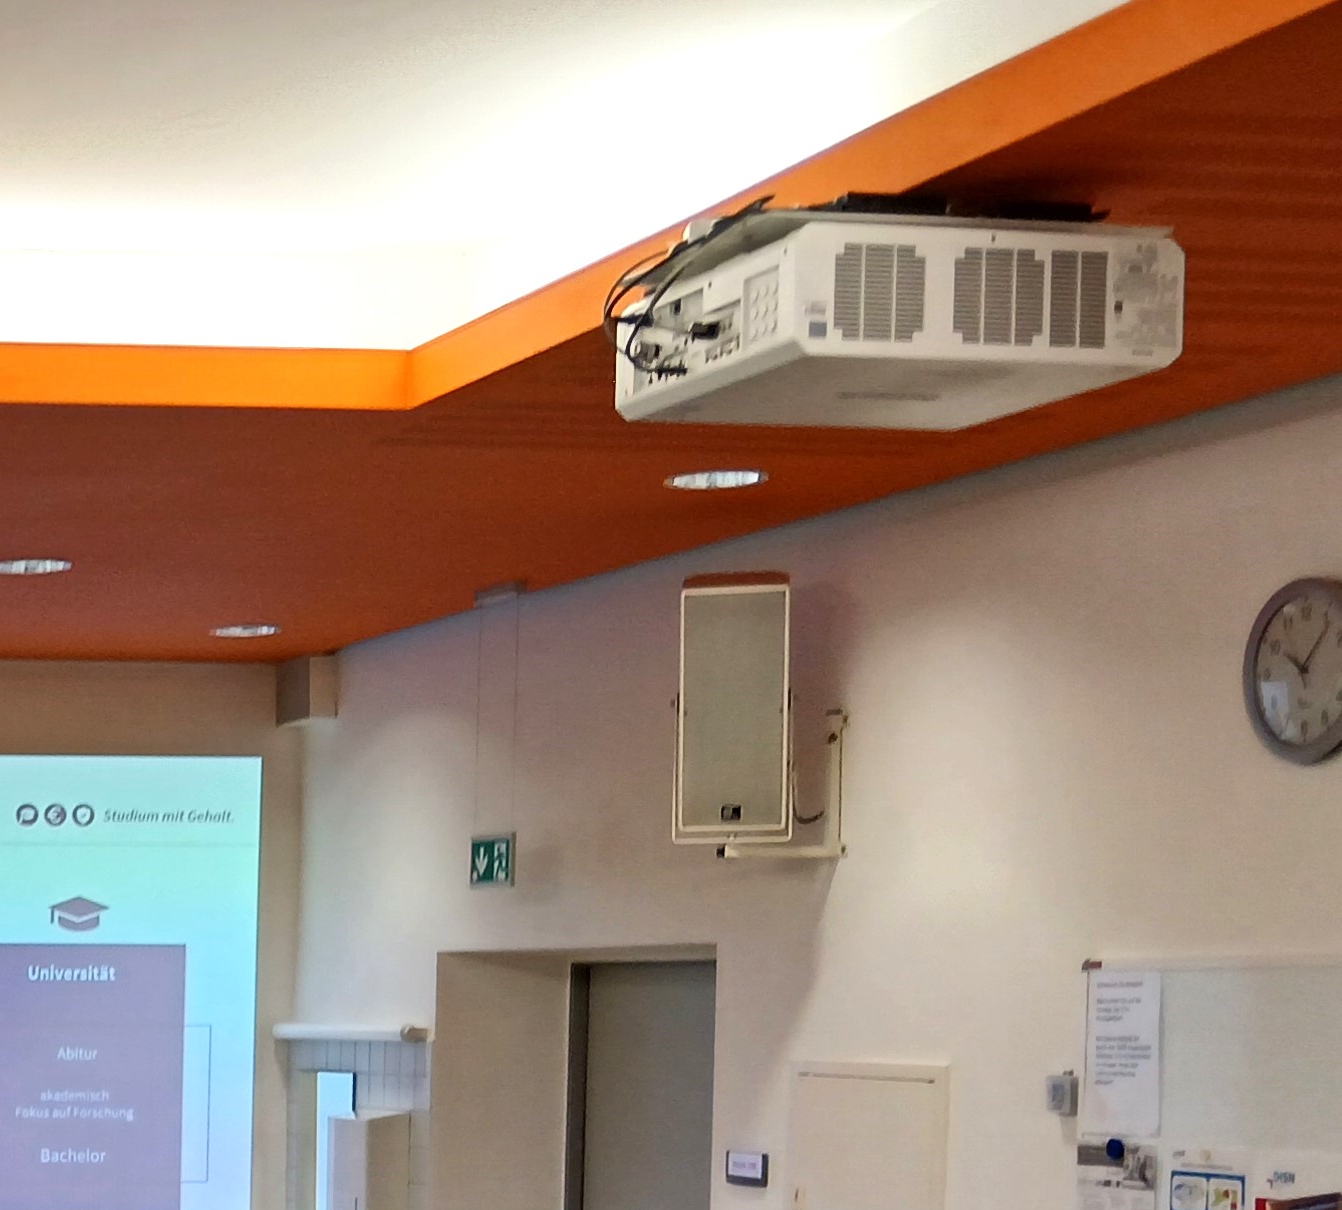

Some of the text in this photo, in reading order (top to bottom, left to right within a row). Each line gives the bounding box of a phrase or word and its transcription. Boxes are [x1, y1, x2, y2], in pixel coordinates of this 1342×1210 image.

[103, 808, 234, 823] Studium mit Gehalt.
[27, 963, 116, 981] Universität
[57, 1047, 98, 1062] Abitur
[40, 1089, 110, 1102] akademisch
[15, 1106, 135, 1123] Fokus auf Forschung
[40, 1148, 106, 1164] Bachelor
